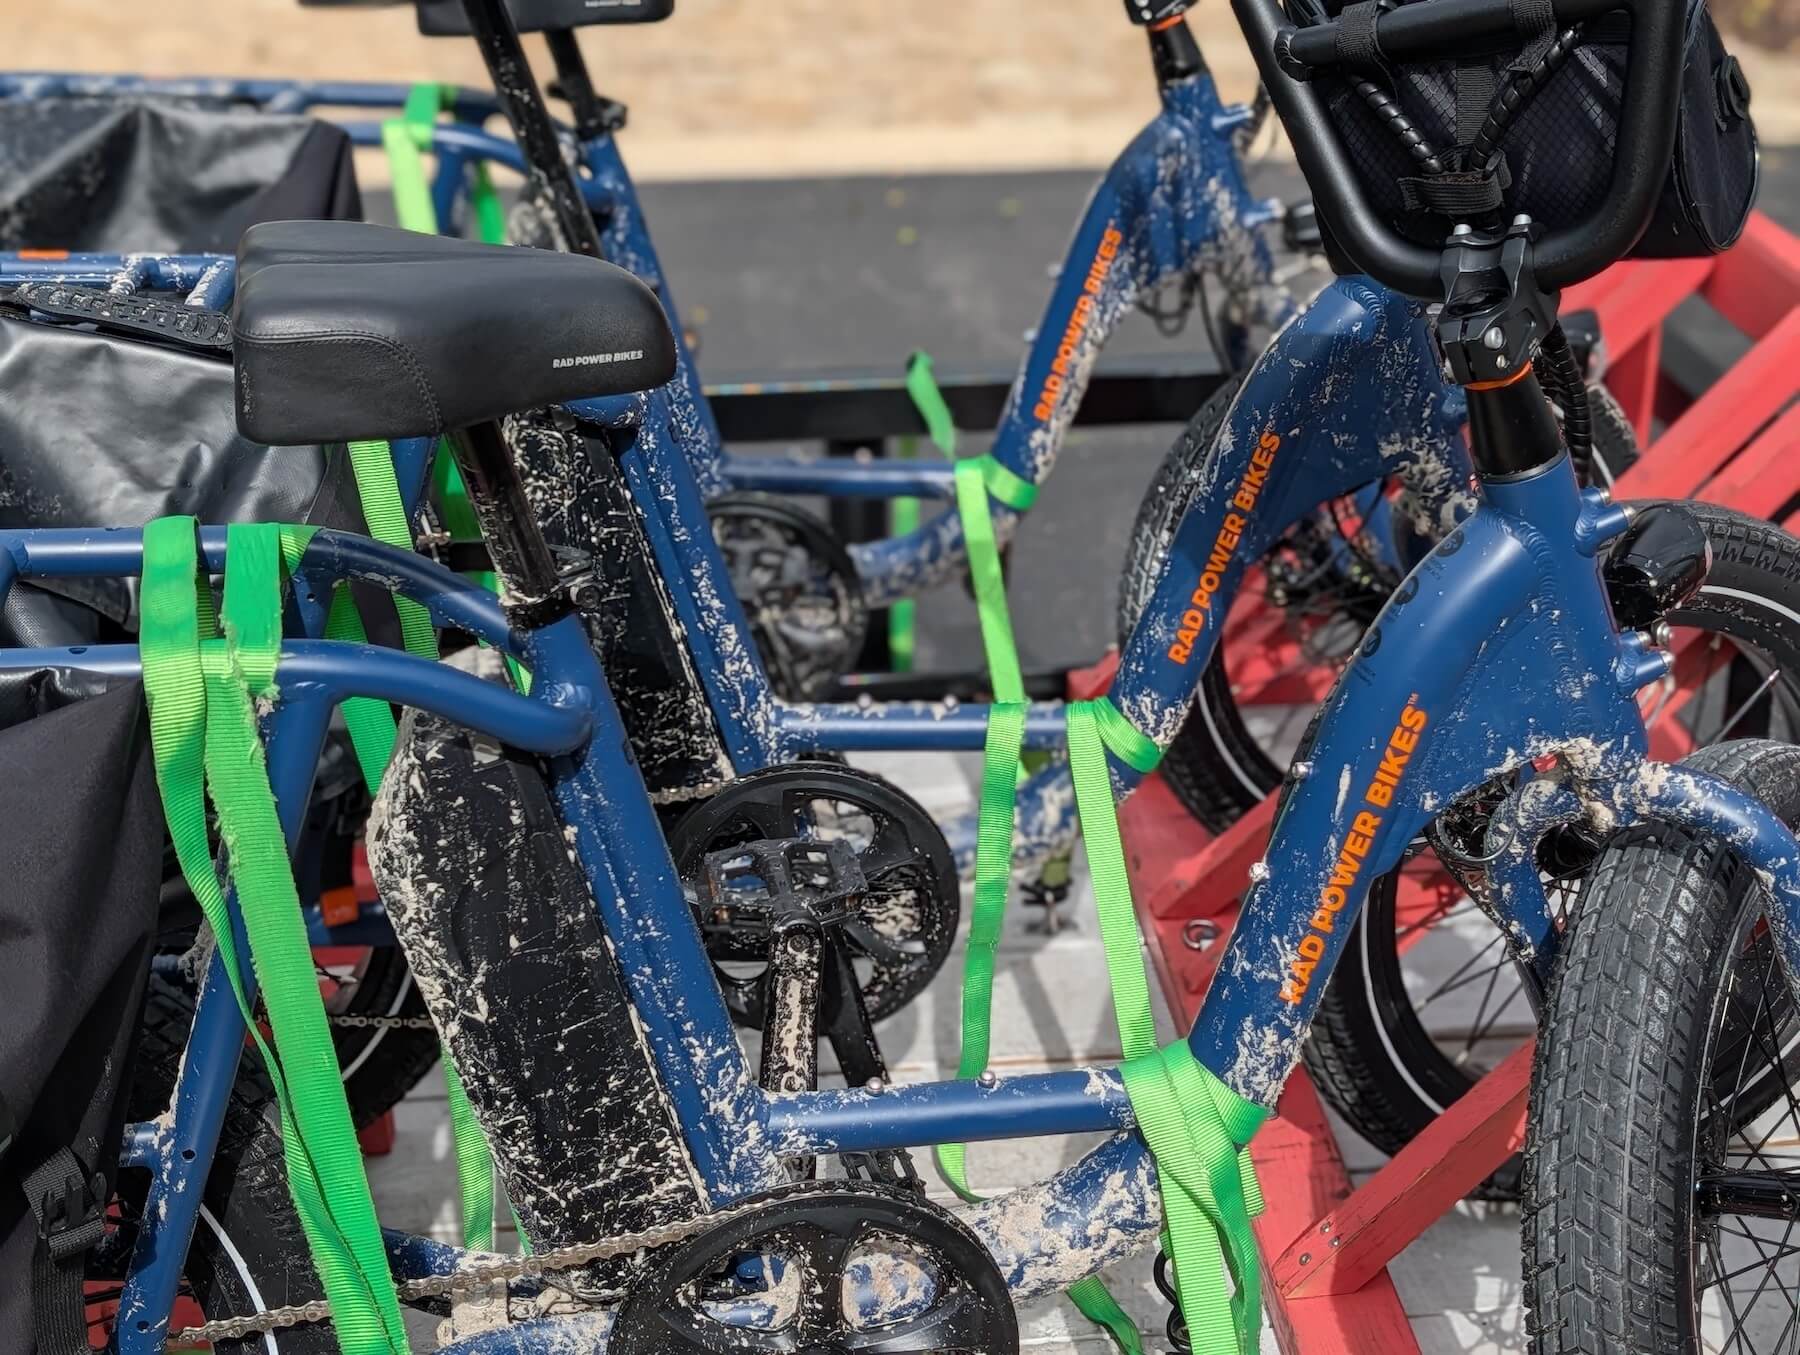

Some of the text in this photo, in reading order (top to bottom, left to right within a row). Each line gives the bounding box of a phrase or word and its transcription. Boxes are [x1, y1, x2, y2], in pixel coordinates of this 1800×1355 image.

[552, 350, 643, 368] RAD POWER BIKES
[1033, 227, 1122, 421] RAD POWER BIKES
[1168, 431, 1281, 665] RAD POWER BIKES
[1279, 934, 1325, 1005] RAD
[1309, 810, 1382, 934] POWER
